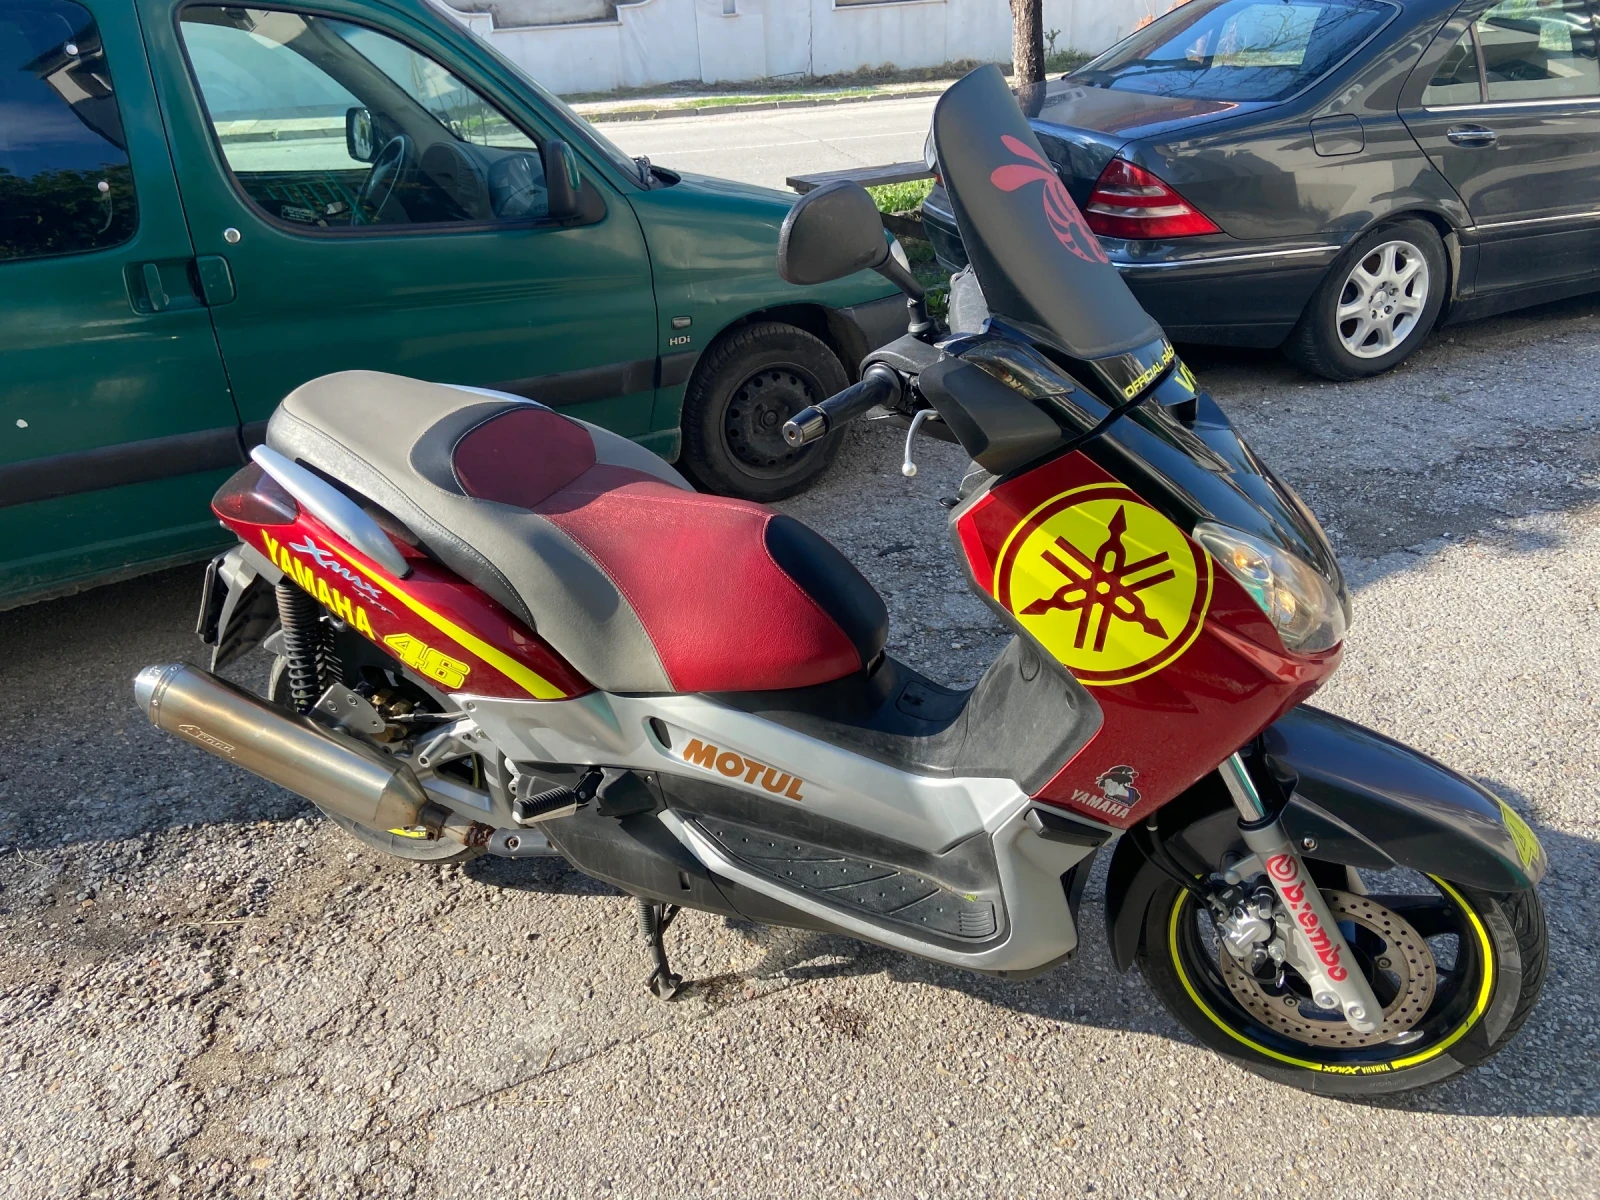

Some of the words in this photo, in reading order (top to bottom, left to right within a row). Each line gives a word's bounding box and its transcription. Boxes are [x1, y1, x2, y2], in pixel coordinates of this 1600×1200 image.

[669, 335, 691, 346] HDi
[1124, 362, 1163, 398] OFFICIAL
[261, 528, 376, 641] YAMAHA
[383, 632, 471, 690] 46
[682, 738, 804, 802] MOTUL
[1070, 788, 1131, 819] YAMAHA
[1280, 880, 1348, 982] brembo
[1360, 1063, 1391, 1075] YAMAHA
